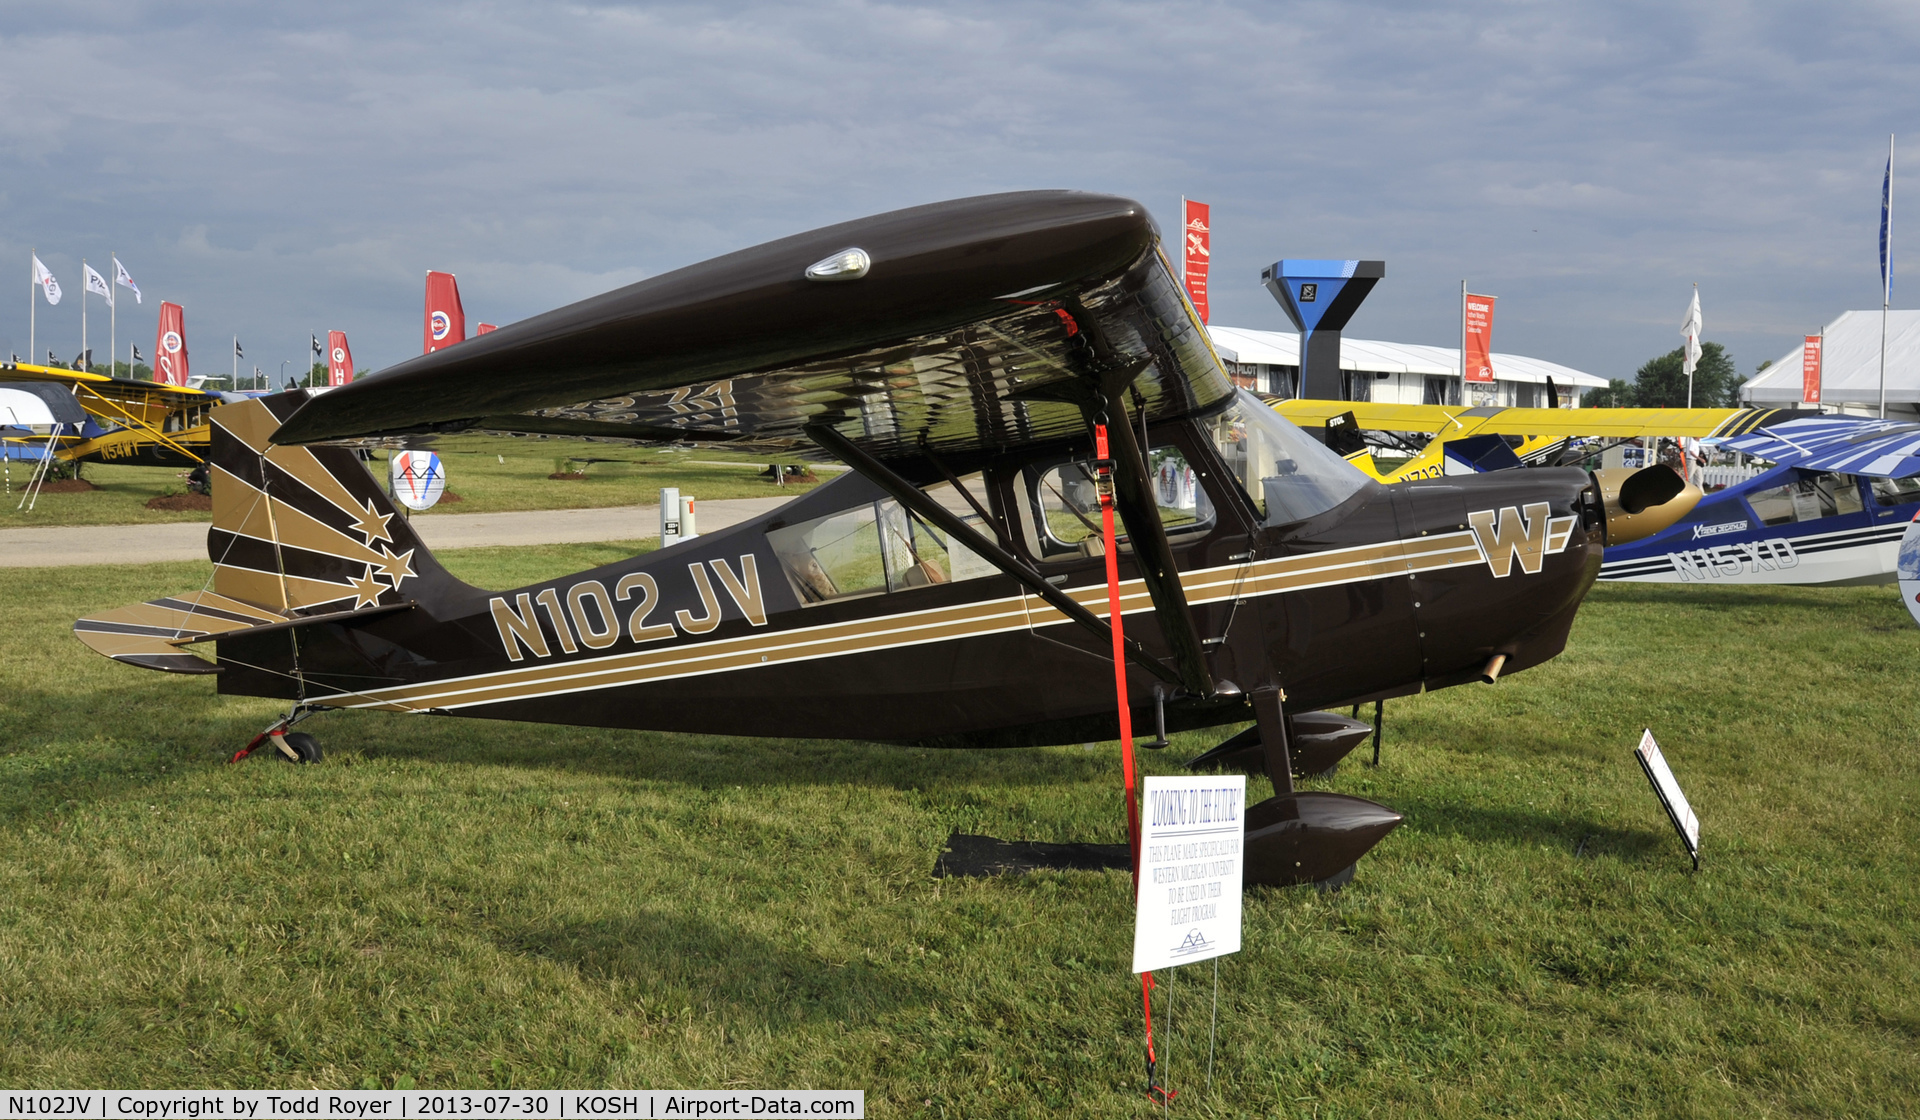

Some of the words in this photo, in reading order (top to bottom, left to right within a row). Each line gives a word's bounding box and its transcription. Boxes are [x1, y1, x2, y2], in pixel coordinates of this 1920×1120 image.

[1239, 365, 1257, 375] PILOT
[1329, 416, 1345, 427] STOL
[1467, 501, 1551, 578] W
[1667, 537, 1799, 582] N15XD
[489, 553, 768, 662] N102JV
[1189, 788, 1198, 825] TO
[1200, 788, 1212, 823] THE
[1149, 846, 1162, 863] THIS
[1163, 844, 1182, 861] PLANE
[1182, 842, 1198, 860] MADE
[1199, 840, 1230, 858] SPECIFICALLY
[1230, 838, 1239, 854] FOR
[1153, 866, 1180, 884] WESTERN
[1180, 863, 1208, 881] MICHIGAN
[1208, 859, 1235, 878] UNIVERSITY
[1168, 888, 1176, 905] TO
[1177, 887, 1185, 903] BE
[1185, 885, 1200, 902] USED
[1200, 883, 1207, 900] IN
[1207, 881, 1221, 898] THEIR
[1171, 907, 1191, 925] FLIGHT
